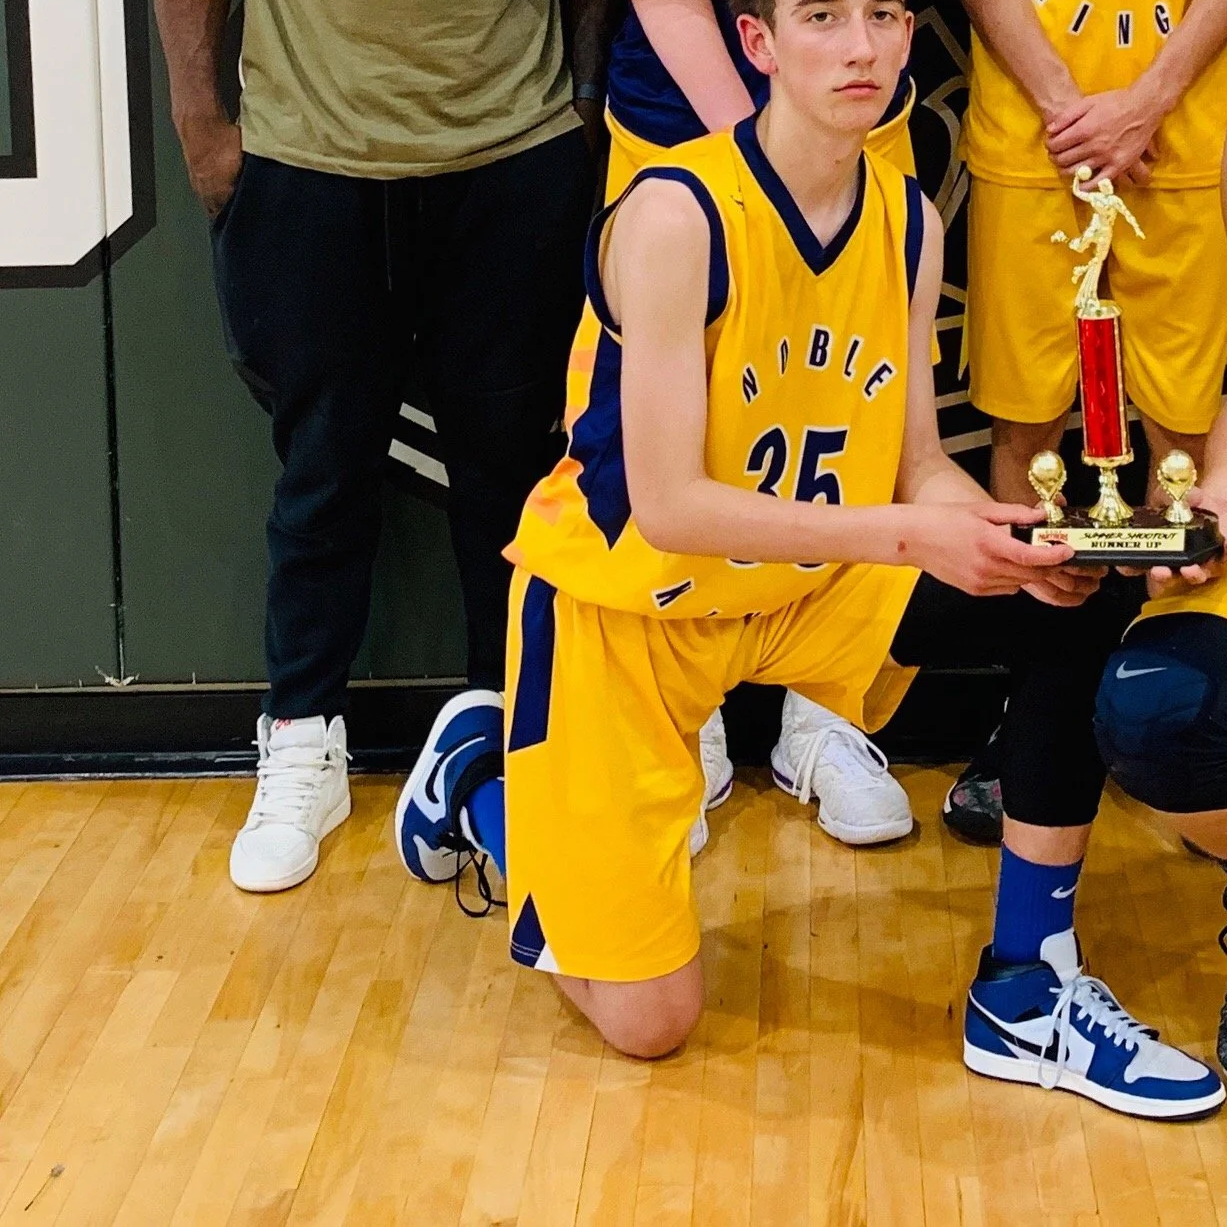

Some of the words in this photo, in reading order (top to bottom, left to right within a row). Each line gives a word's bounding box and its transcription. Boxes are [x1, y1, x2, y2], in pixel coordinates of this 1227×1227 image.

[1080, 531, 1123, 540] SUMMER
[1123, 531, 1178, 540] SHOOTOUT
[1091, 541, 1141, 549] RUNNER
[1146, 541, 1162, 549] UP
